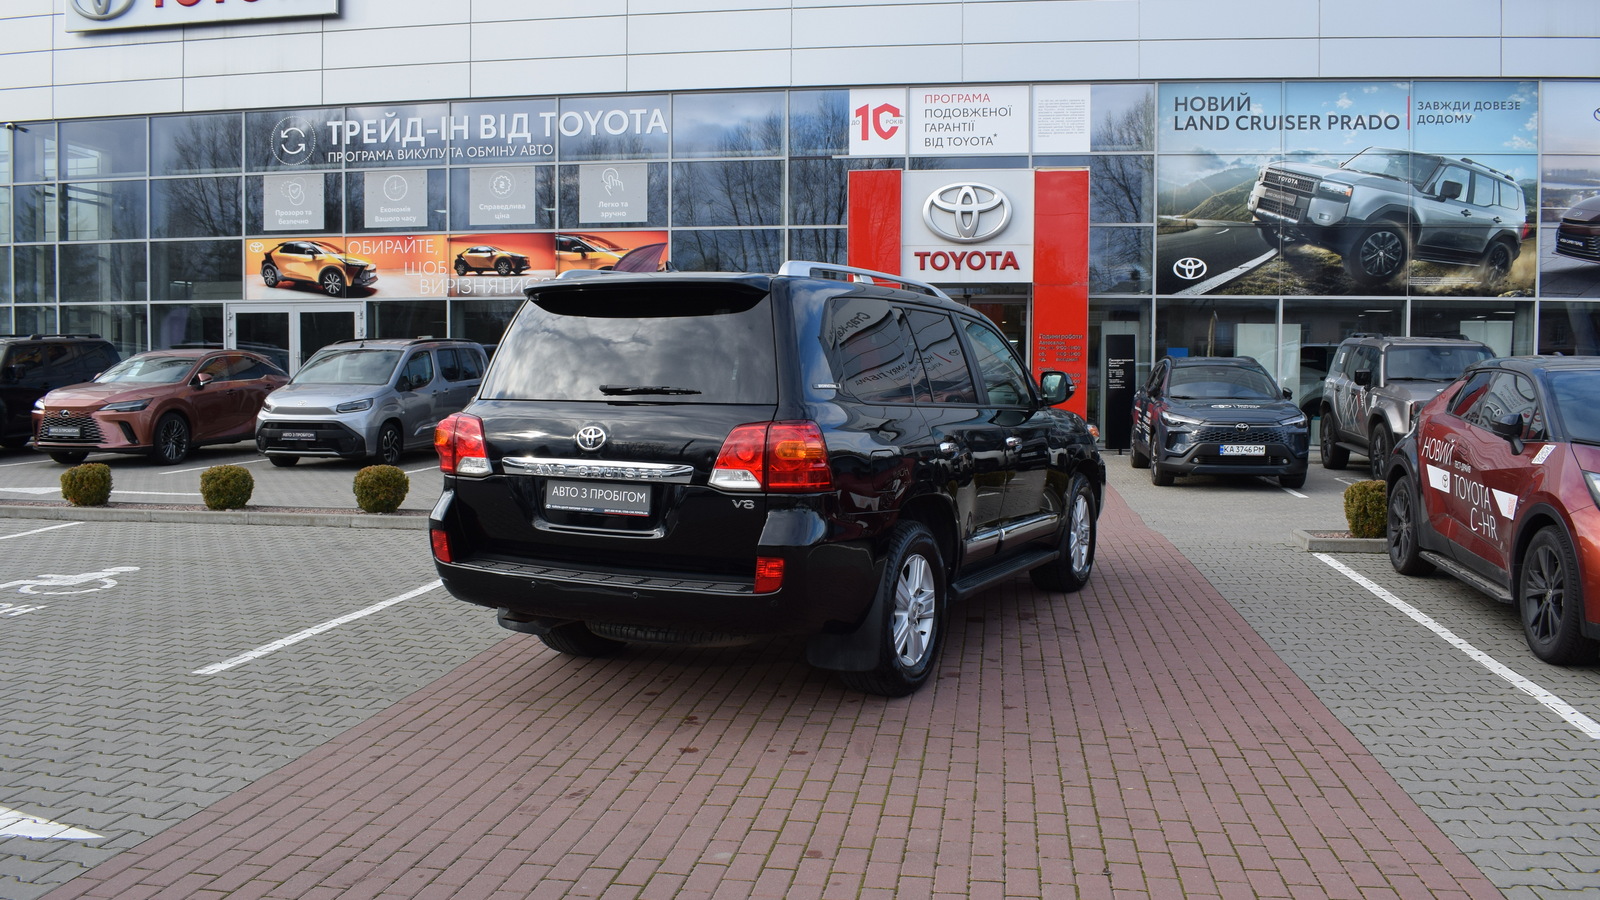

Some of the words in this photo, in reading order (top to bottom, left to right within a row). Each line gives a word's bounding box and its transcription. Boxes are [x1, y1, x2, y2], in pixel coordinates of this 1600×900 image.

[924, 93, 991, 104] ПРОГРАМА
[1174, 92, 1251, 112] НОВИЙ
[924, 105, 1012, 120] ПОДОВЖЕНОЇ
[1417, 101, 1470, 112] ЗАВЖДИ
[1473, 101, 1521, 112] ДОВЕЗЕ
[924, 120, 975, 133] ГАРАНТІЇ
[1174, 115, 1229, 131] LAND
[1235, 114, 1322, 131] CRUISER
[1328, 114, 1400, 130] PRADO
[1417, 114, 1473, 125] ДОДОМУ
[326, 111, 470, 148] ТРЕЙД-ІН
[480, 113, 532, 144] ВІД
[539, 108, 668, 137] TOYOTA
[924, 137, 943, 148] ВІД
[328, 150, 394, 163] ПРОГРАМА
[398, 147, 447, 160] ВИКУПУ
[450, 147, 463, 158] ТА
[467, 145, 518, 158] ОБМІНУ
[520, 143, 553, 156] АВТО
[1277, 175, 1298, 185] TOYOTA
[275, 209, 304, 217] Прозоро
[479, 203, 526, 211] Справедлива
[375, 215, 400, 223] Вашого
[401, 215, 416, 223] часу
[494, 212, 510, 220] ціна
[600, 211, 627, 219] зручно
[347, 236, 439, 256] ОБИРАЙТЕ,
[914, 250, 1020, 271] TOYOTA
[404, 260, 447, 277] ЩОБ
[1235, 445, 1253, 453] 3746
[1421, 437, 1456, 466] НОВИЙ
[524, 463, 567, 476] LAND
[578, 465, 663, 480] CRUISER
[552, 486, 578, 498] АВТО
[581, 488, 588, 499] З
[590, 488, 646, 503] ПРОБІГОМ
[1453, 473, 1492, 512] TOYOTA
[732, 499, 755, 509] V8
[1470, 507, 1498, 541] C-HR
